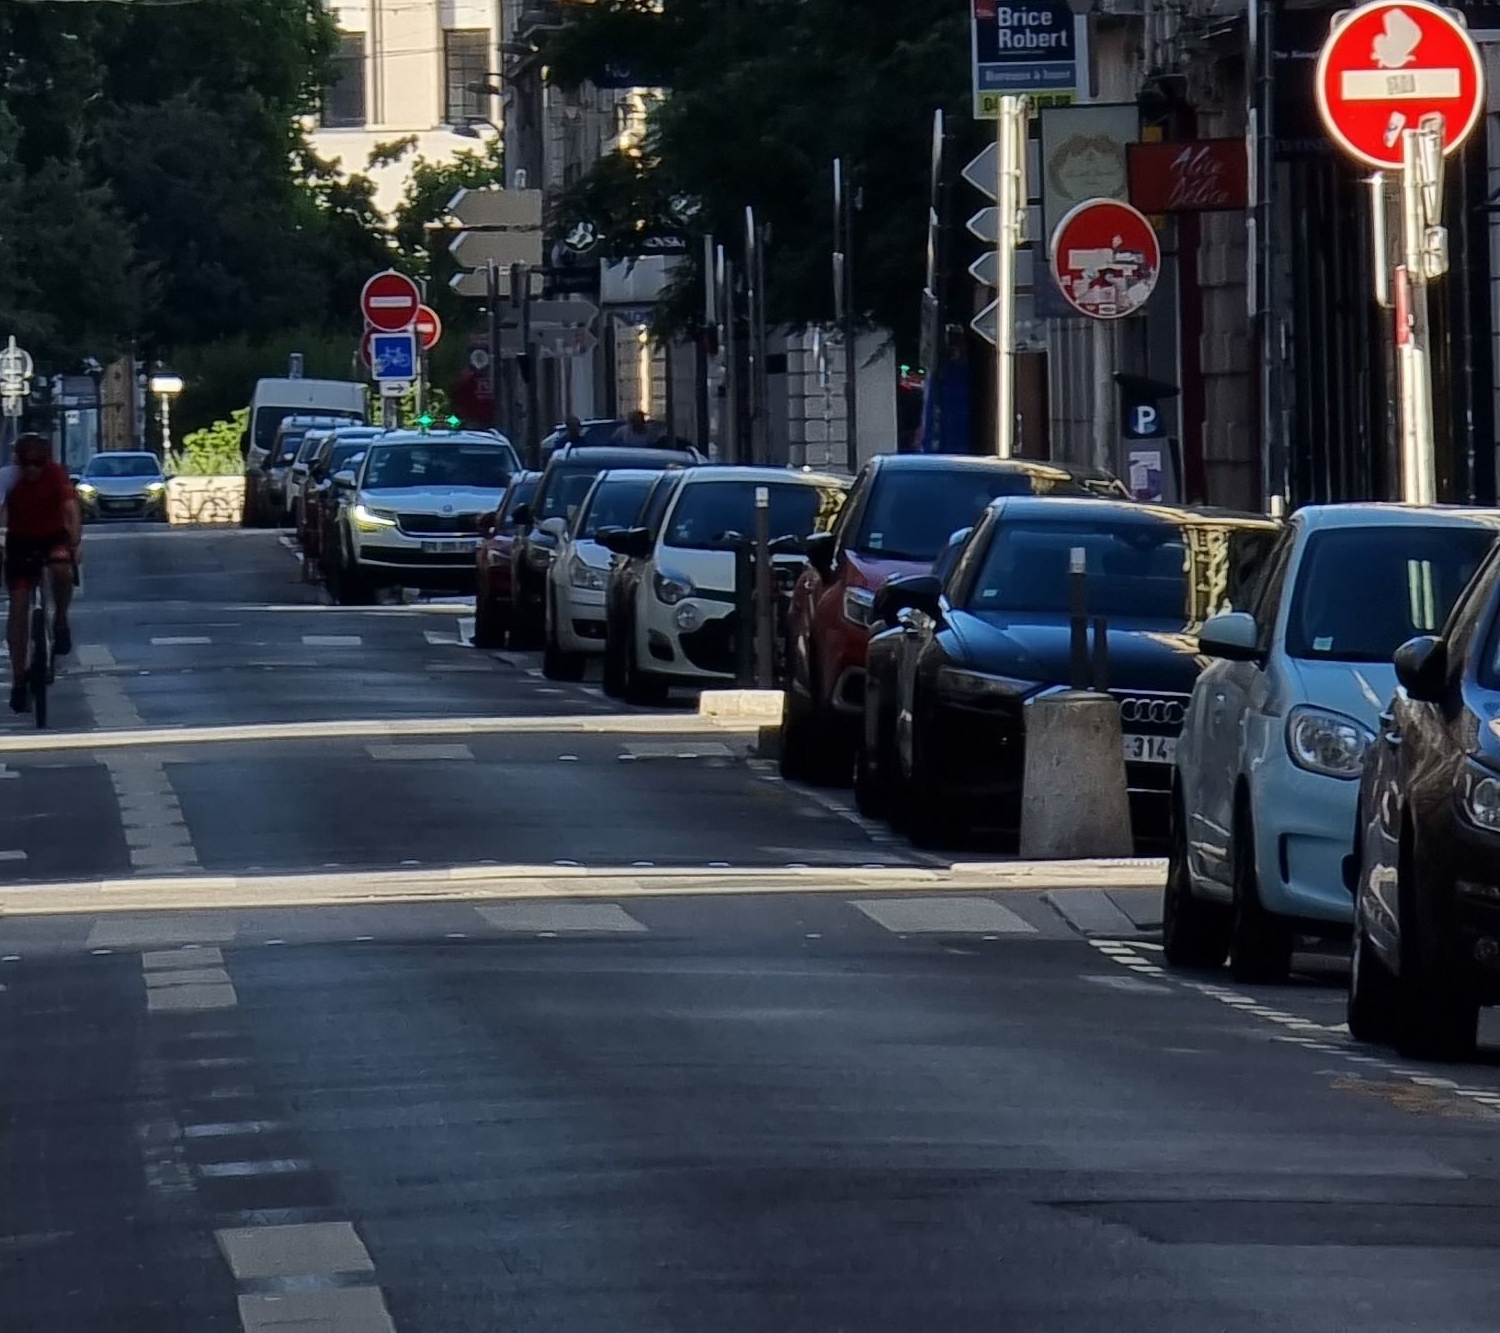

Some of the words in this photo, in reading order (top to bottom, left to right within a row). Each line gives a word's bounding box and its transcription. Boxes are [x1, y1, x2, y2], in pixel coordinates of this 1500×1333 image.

[997, 6, 1053, 27] Brice
[998, 28, 1069, 48] Robert
[1136, 405, 1156, 434] P
